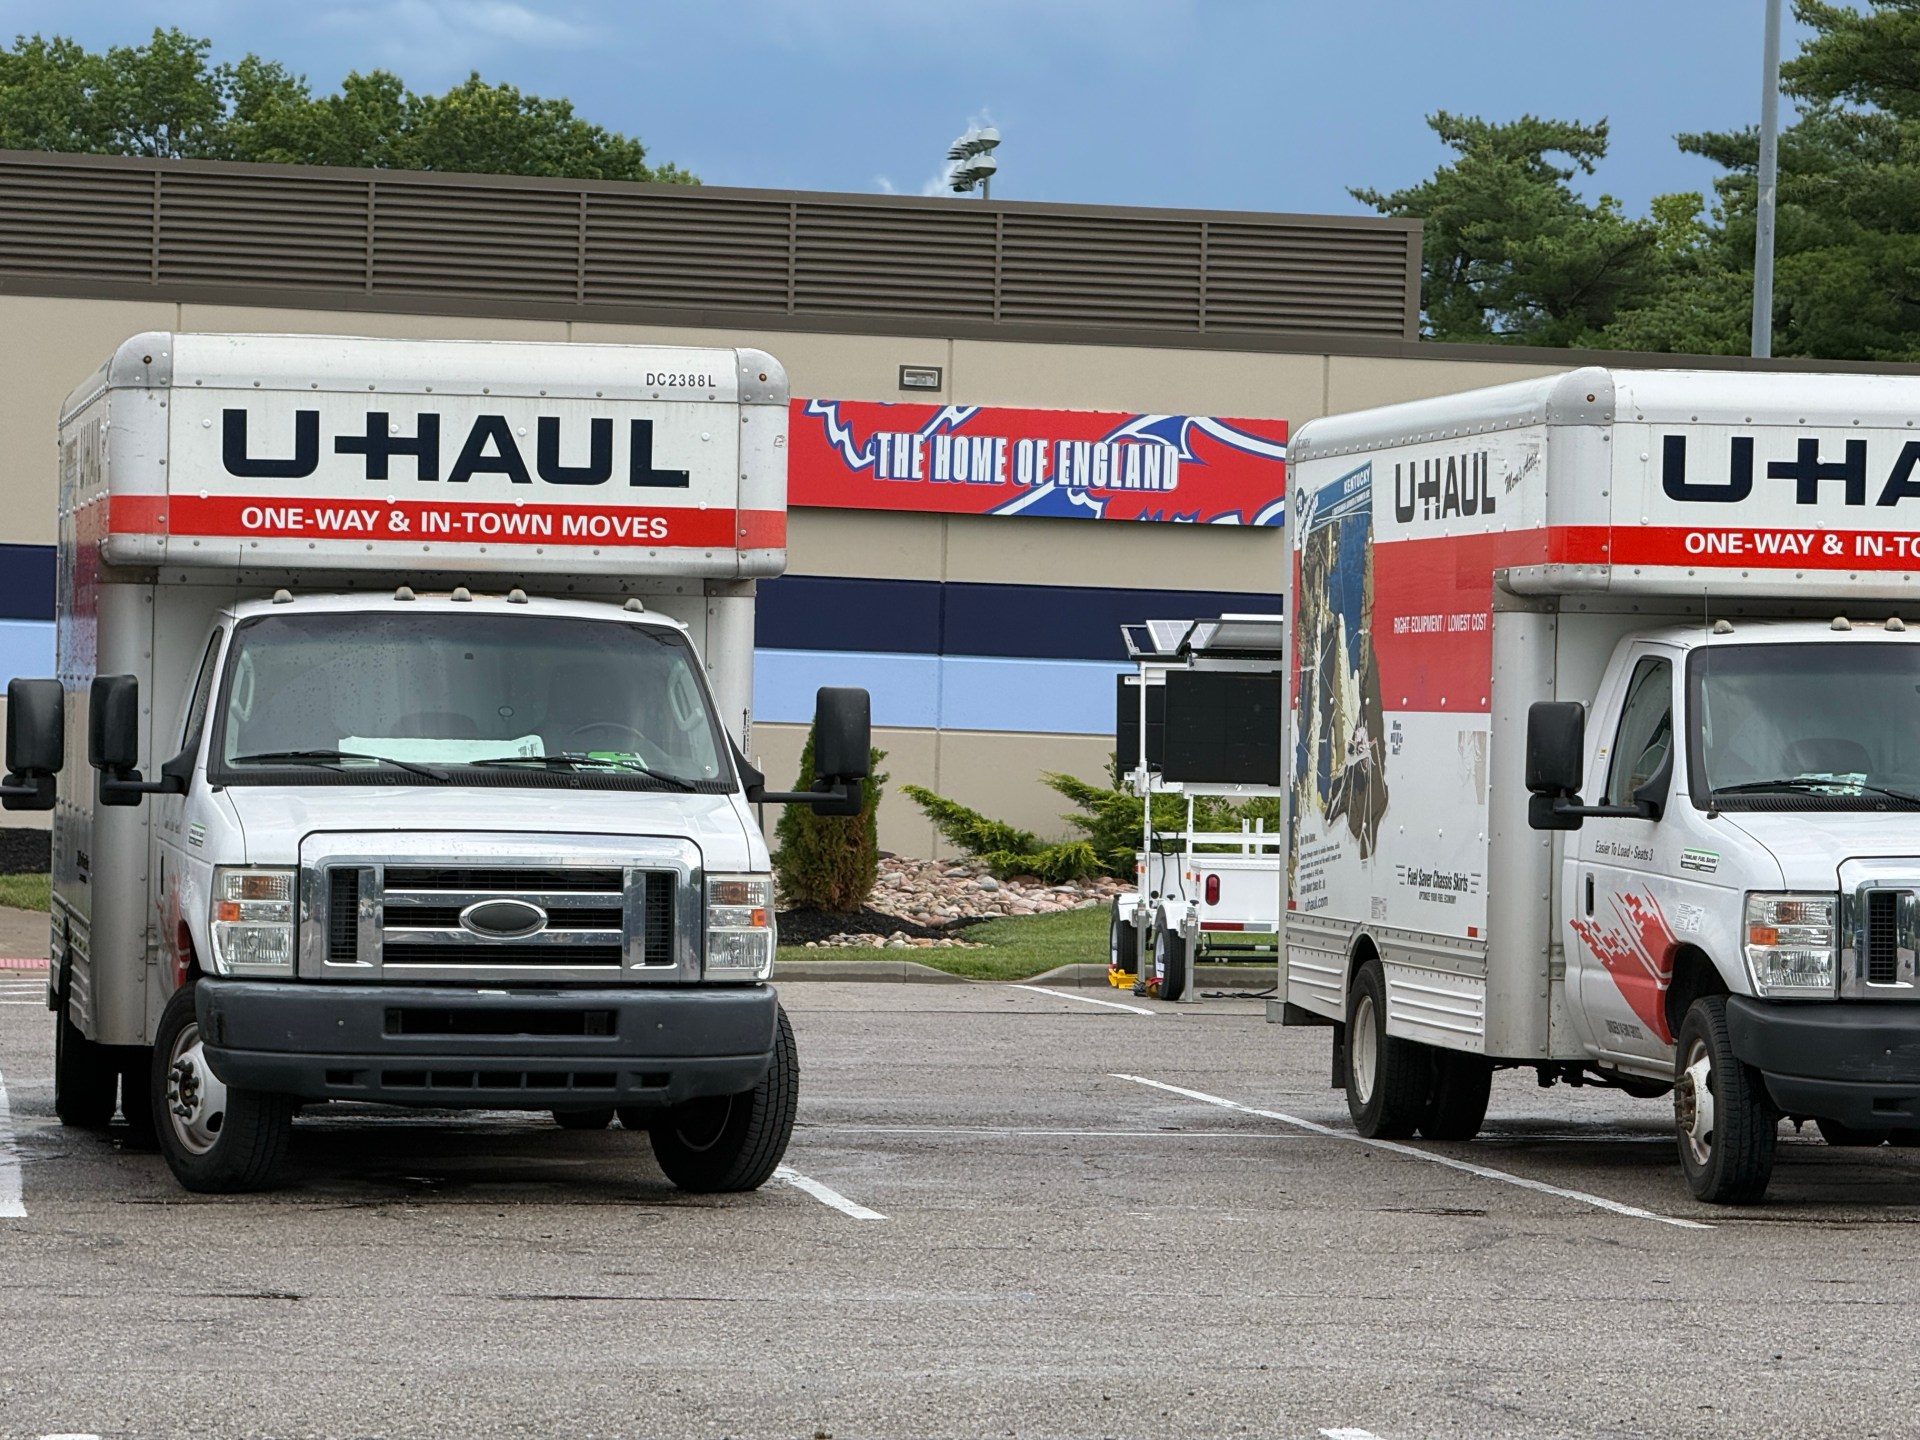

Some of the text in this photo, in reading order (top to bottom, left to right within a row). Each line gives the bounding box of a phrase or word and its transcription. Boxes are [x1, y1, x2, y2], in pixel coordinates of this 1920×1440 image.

[646, 373, 717, 388] DC2388L
[222, 408, 690, 488] U-HAUL
[873, 432, 1180, 491] THE HOME OF ENGLAND
[1343, 466, 1371, 495] KENTUCKY
[1395, 451, 1496, 523] U-HAUL
[241, 506, 668, 539] ONE-WAY & IN-TOWN MOVES
[1685, 532, 1815, 555] ONE-WAY
[1822, 533, 1844, 555] &
[1394, 617, 1410, 634] RIGHT
[1411, 615, 1443, 633] EQUIPMENT
[1448, 614, 1471, 632] LOWEST
[1472, 613, 1487, 631] COST
[1595, 840, 1611, 854] Easier
[1611, 842, 1617, 856] To
[1617, 843, 1630, 857] Load
[1634, 846, 1649, 860] Seats
[1407, 867, 1468, 892] Fuel Saver Chassis Skirts
